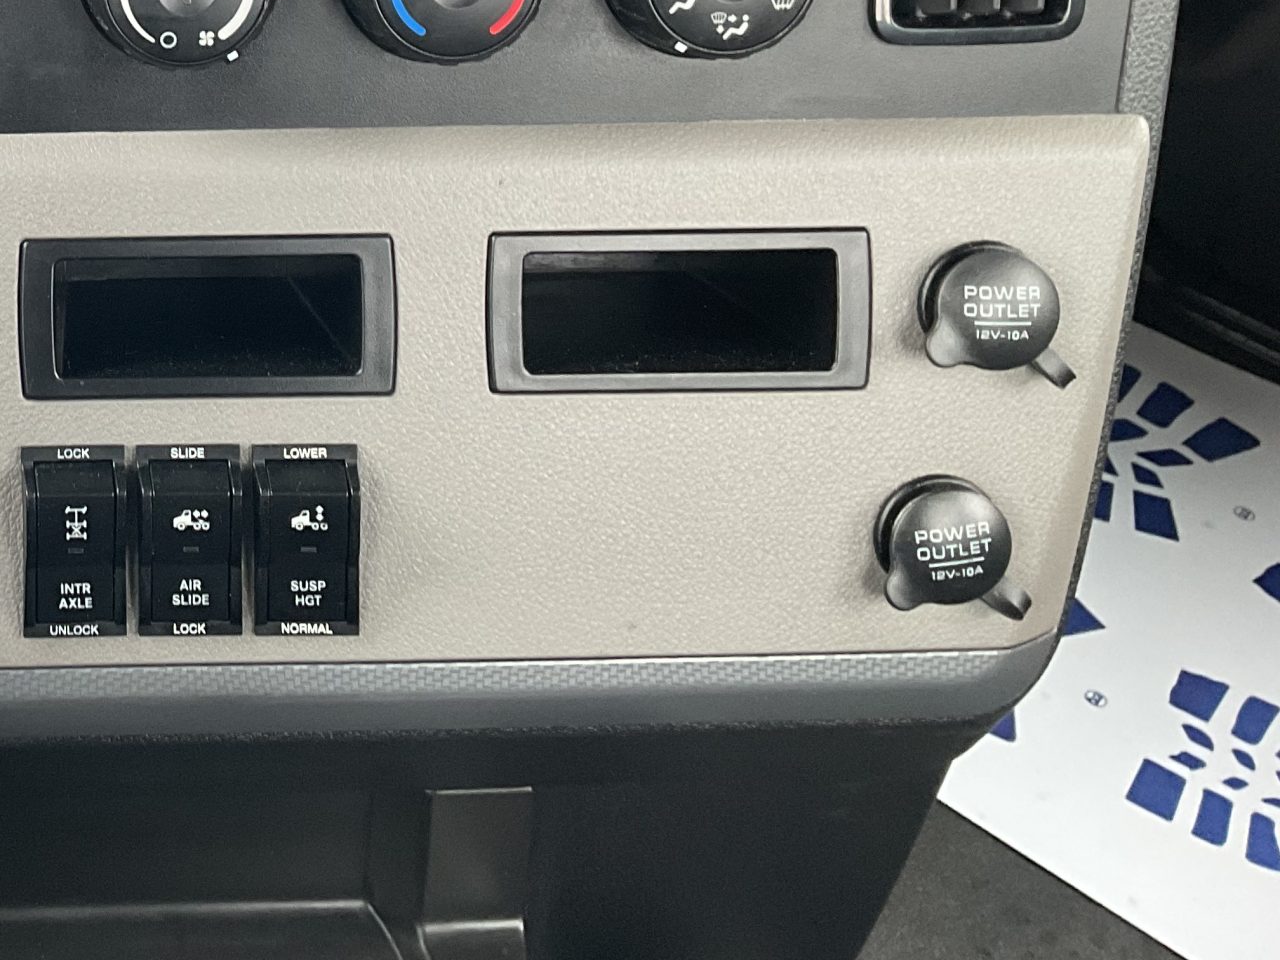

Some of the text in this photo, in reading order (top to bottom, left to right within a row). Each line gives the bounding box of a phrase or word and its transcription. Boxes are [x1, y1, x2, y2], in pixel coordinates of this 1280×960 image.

[964, 285, 1040, 300] POWER
[963, 303, 1041, 318] OUTLET
[976, 329, 1030, 340] 12V-10A
[57, 448, 90, 460] LOCK
[170, 447, 205, 459] SLIDE
[283, 447, 327, 459] LOWER
[914, 521, 990, 544] POWER
[916, 537, 992, 561] OUTLET
[931, 565, 984, 581] 12V-10A
[60, 582, 91, 594] INTR
[179, 579, 202, 591] AIR
[290, 580, 326, 592] SUSP
[58, 597, 93, 610] AXLE
[171, 594, 210, 606] SLIDE
[295, 594, 322, 607] HGT
[49, 624, 99, 636] UNLOCK
[173, 623, 207, 635] LOCK
[280, 622, 333, 635] NORMAL
